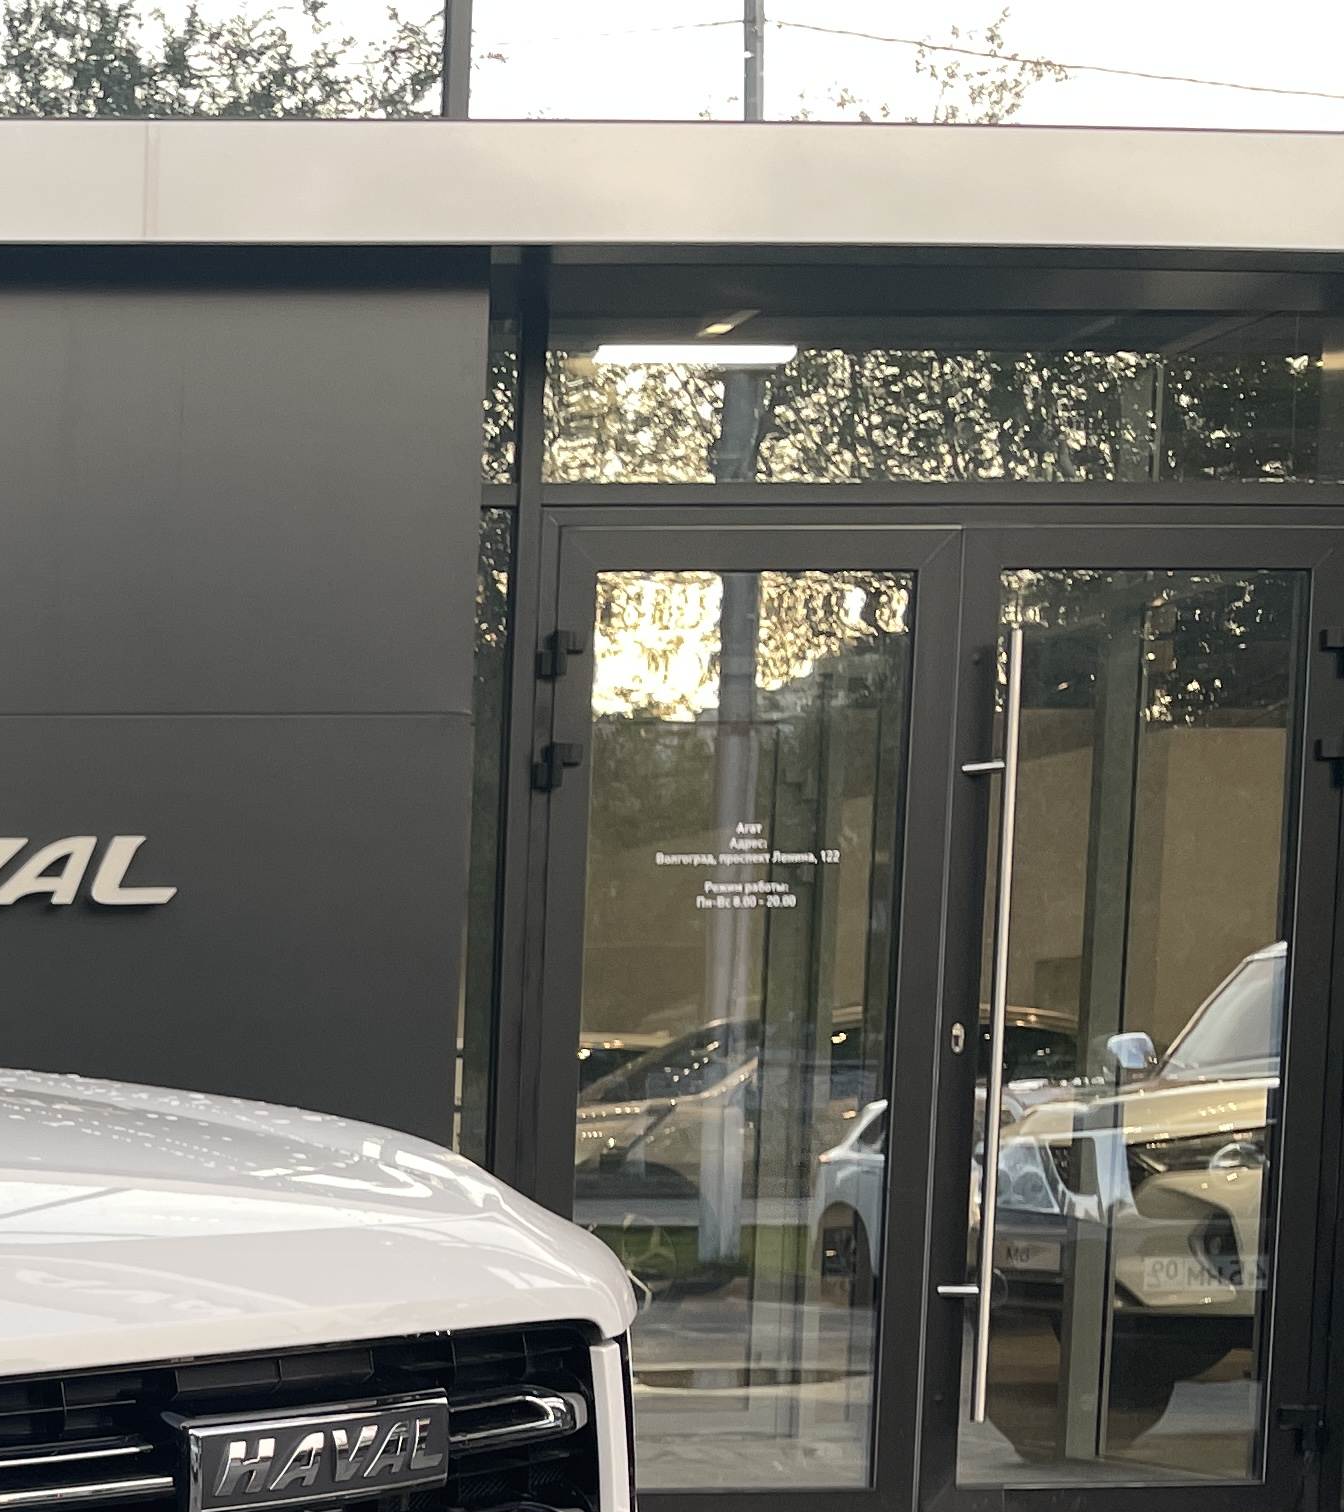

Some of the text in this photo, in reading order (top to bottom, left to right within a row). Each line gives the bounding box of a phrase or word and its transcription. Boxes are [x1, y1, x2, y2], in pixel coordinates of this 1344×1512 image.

[735, 821, 763, 835] Агат
[729, 836, 768, 850] Адрес:
[719, 852, 771, 866] проспект
[820, 849, 841, 864] 122
[704, 880, 743, 894] Режим
[214, 1416, 444, 1497] HAVAL
